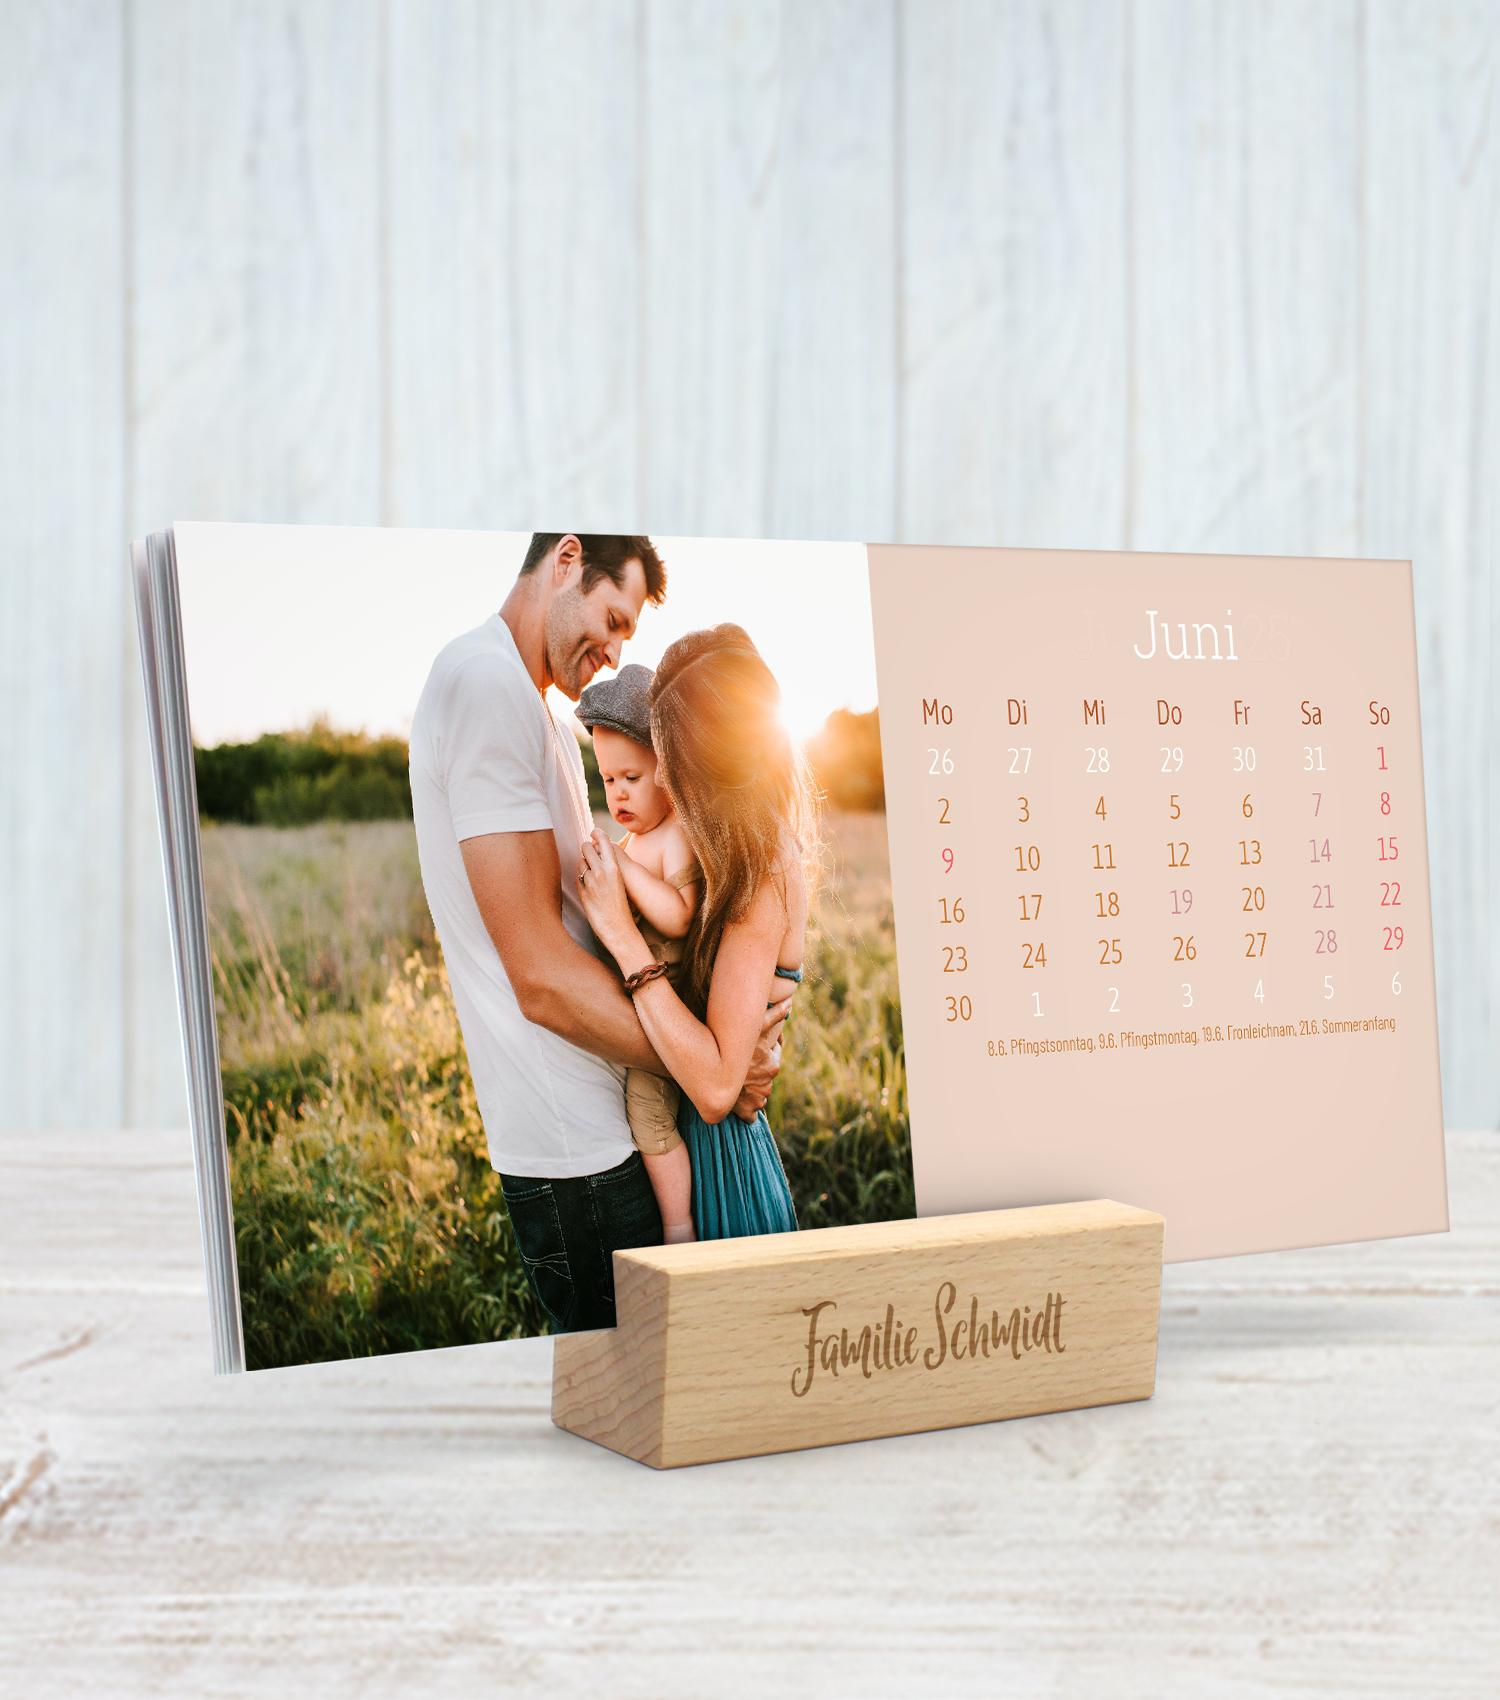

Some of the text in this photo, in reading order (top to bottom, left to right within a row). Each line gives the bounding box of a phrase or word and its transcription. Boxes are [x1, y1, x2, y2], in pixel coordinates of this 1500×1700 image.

[1134, 610, 1238, 660] Juni
[923, 698, 1390, 726] Mo Di Mi Do Fr Sa So
[928, 747, 1388, 774] 26 27 28 29 30 31 1
[937, 791, 1391, 825] 2 3 4 5 6 7 8
[942, 837, 1398, 874] 9 10 11 12 13 14 15
[938, 882, 1401, 924] 16 17 18 19 20 21 22
[942, 927, 1404, 973] 23 24 25 26 27 28 29
[946, 972, 1401, 1022] 30 1 2 3 4 5 6
[988, 1015, 1396, 1057] 8.6. Pfingstsonntag, 9.6. Pfingstmontag, 19.6. Fronleichnam, 21.6. Sommeranfang
[791, 1281, 1067, 1398] Familie Schmidt
